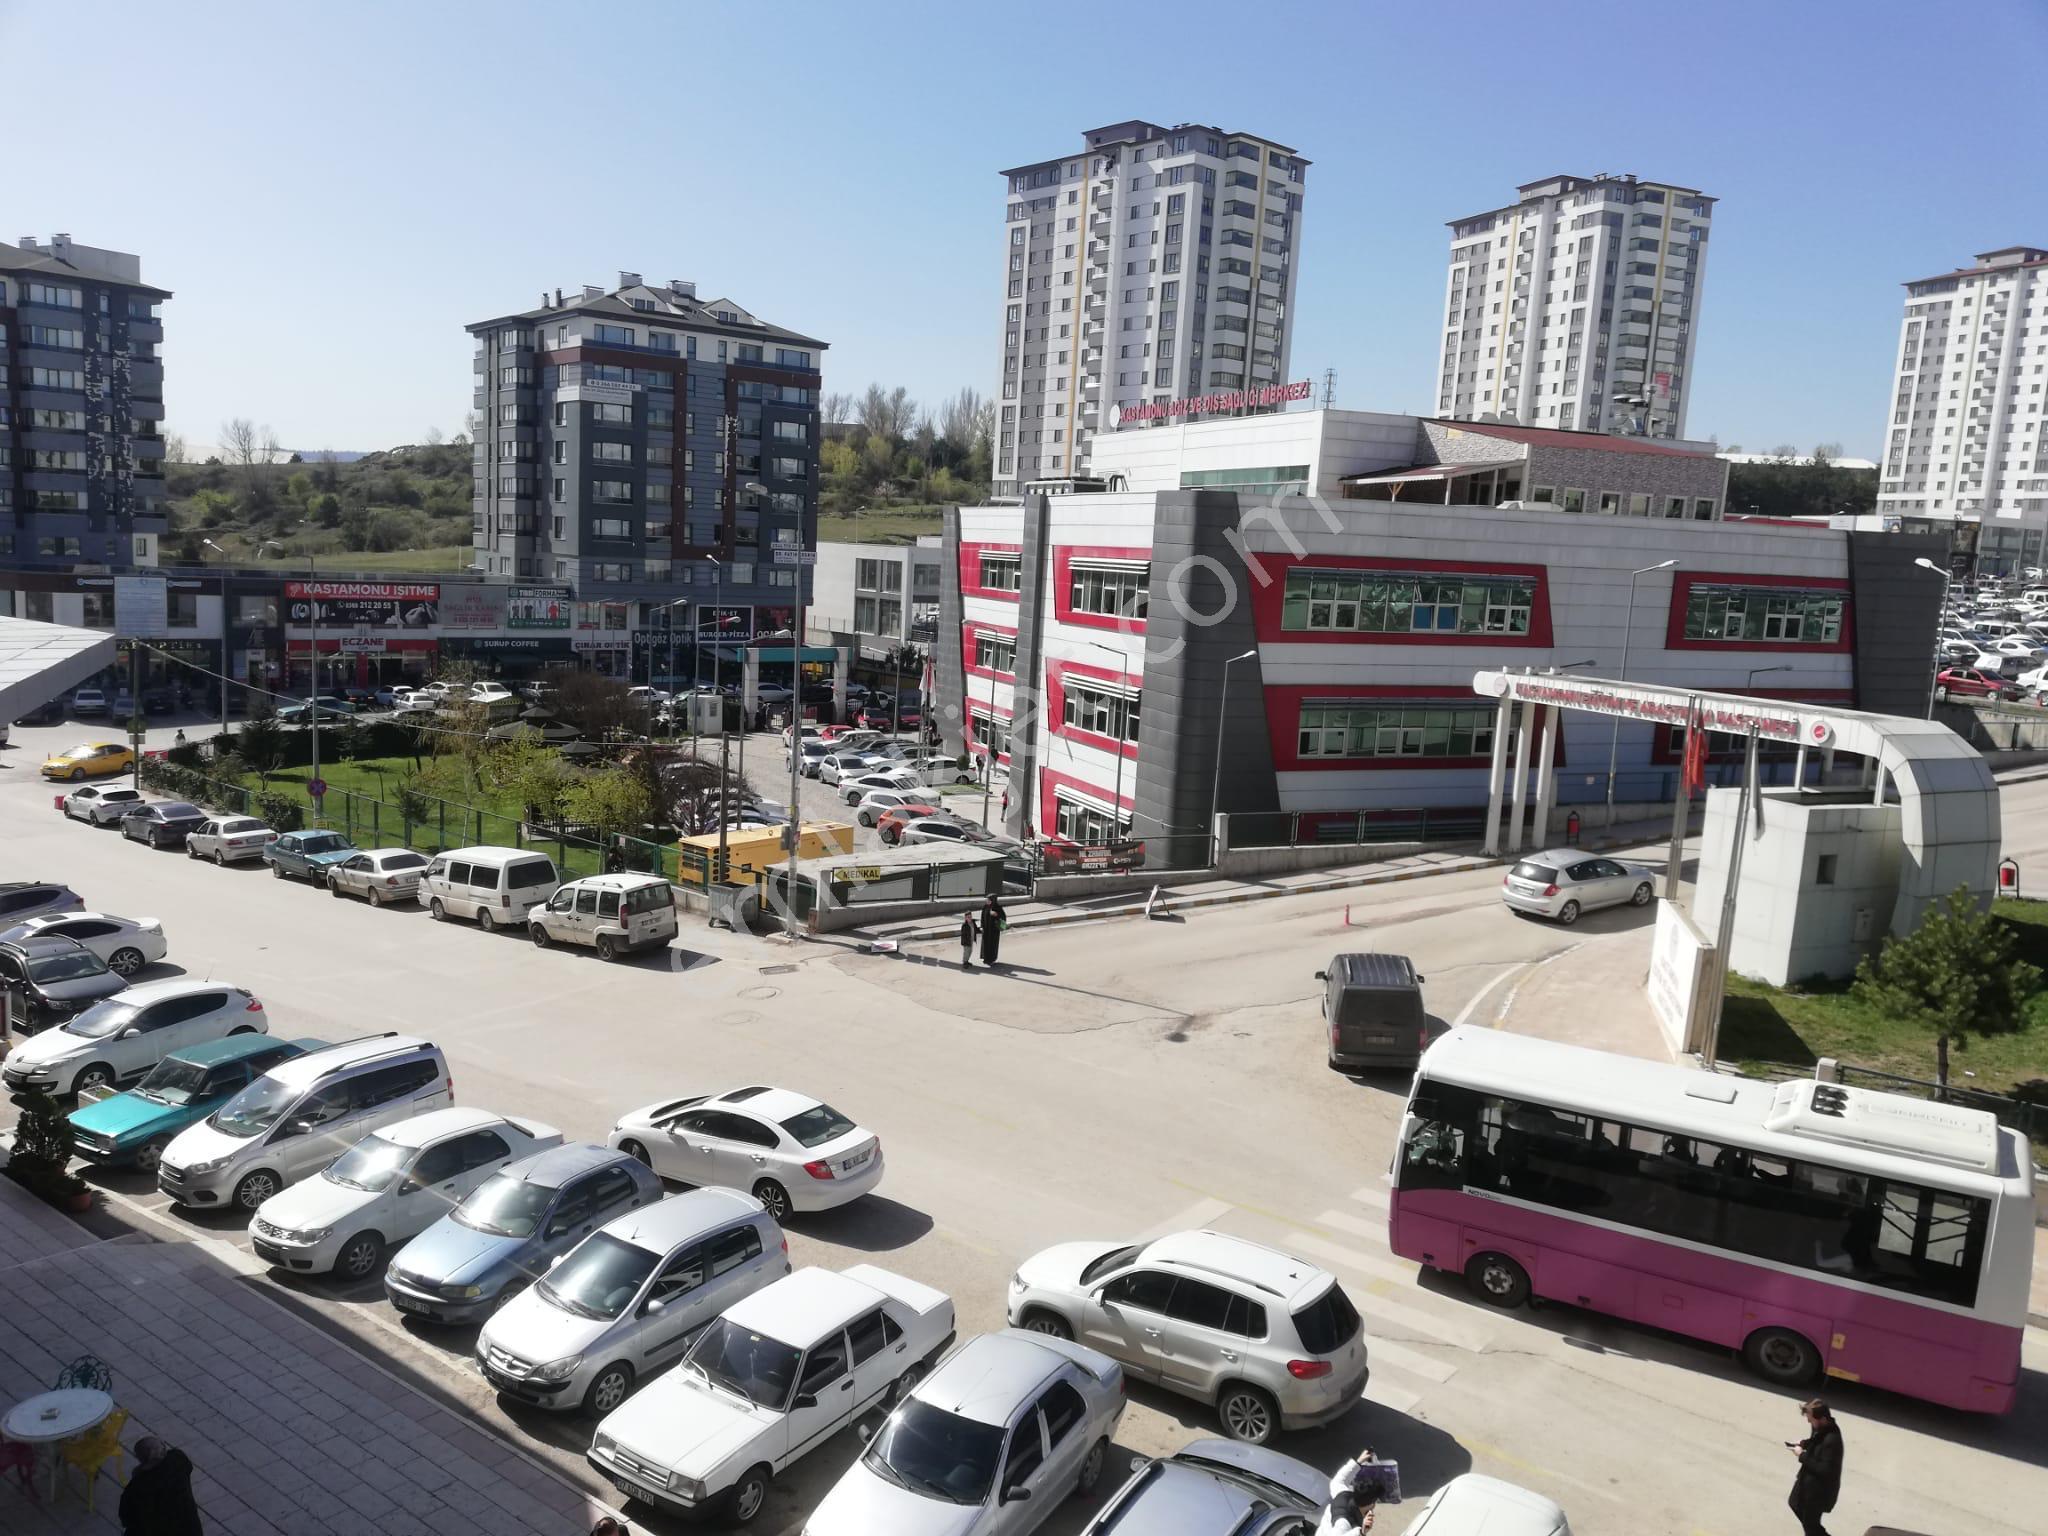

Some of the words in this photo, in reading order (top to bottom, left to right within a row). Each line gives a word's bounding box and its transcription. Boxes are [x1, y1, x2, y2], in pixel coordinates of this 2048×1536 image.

[303, 583, 390, 596] KASTAMONU
[342, 637, 384, 646] ECZANE
[511, 640, 540, 648] COFFEE
